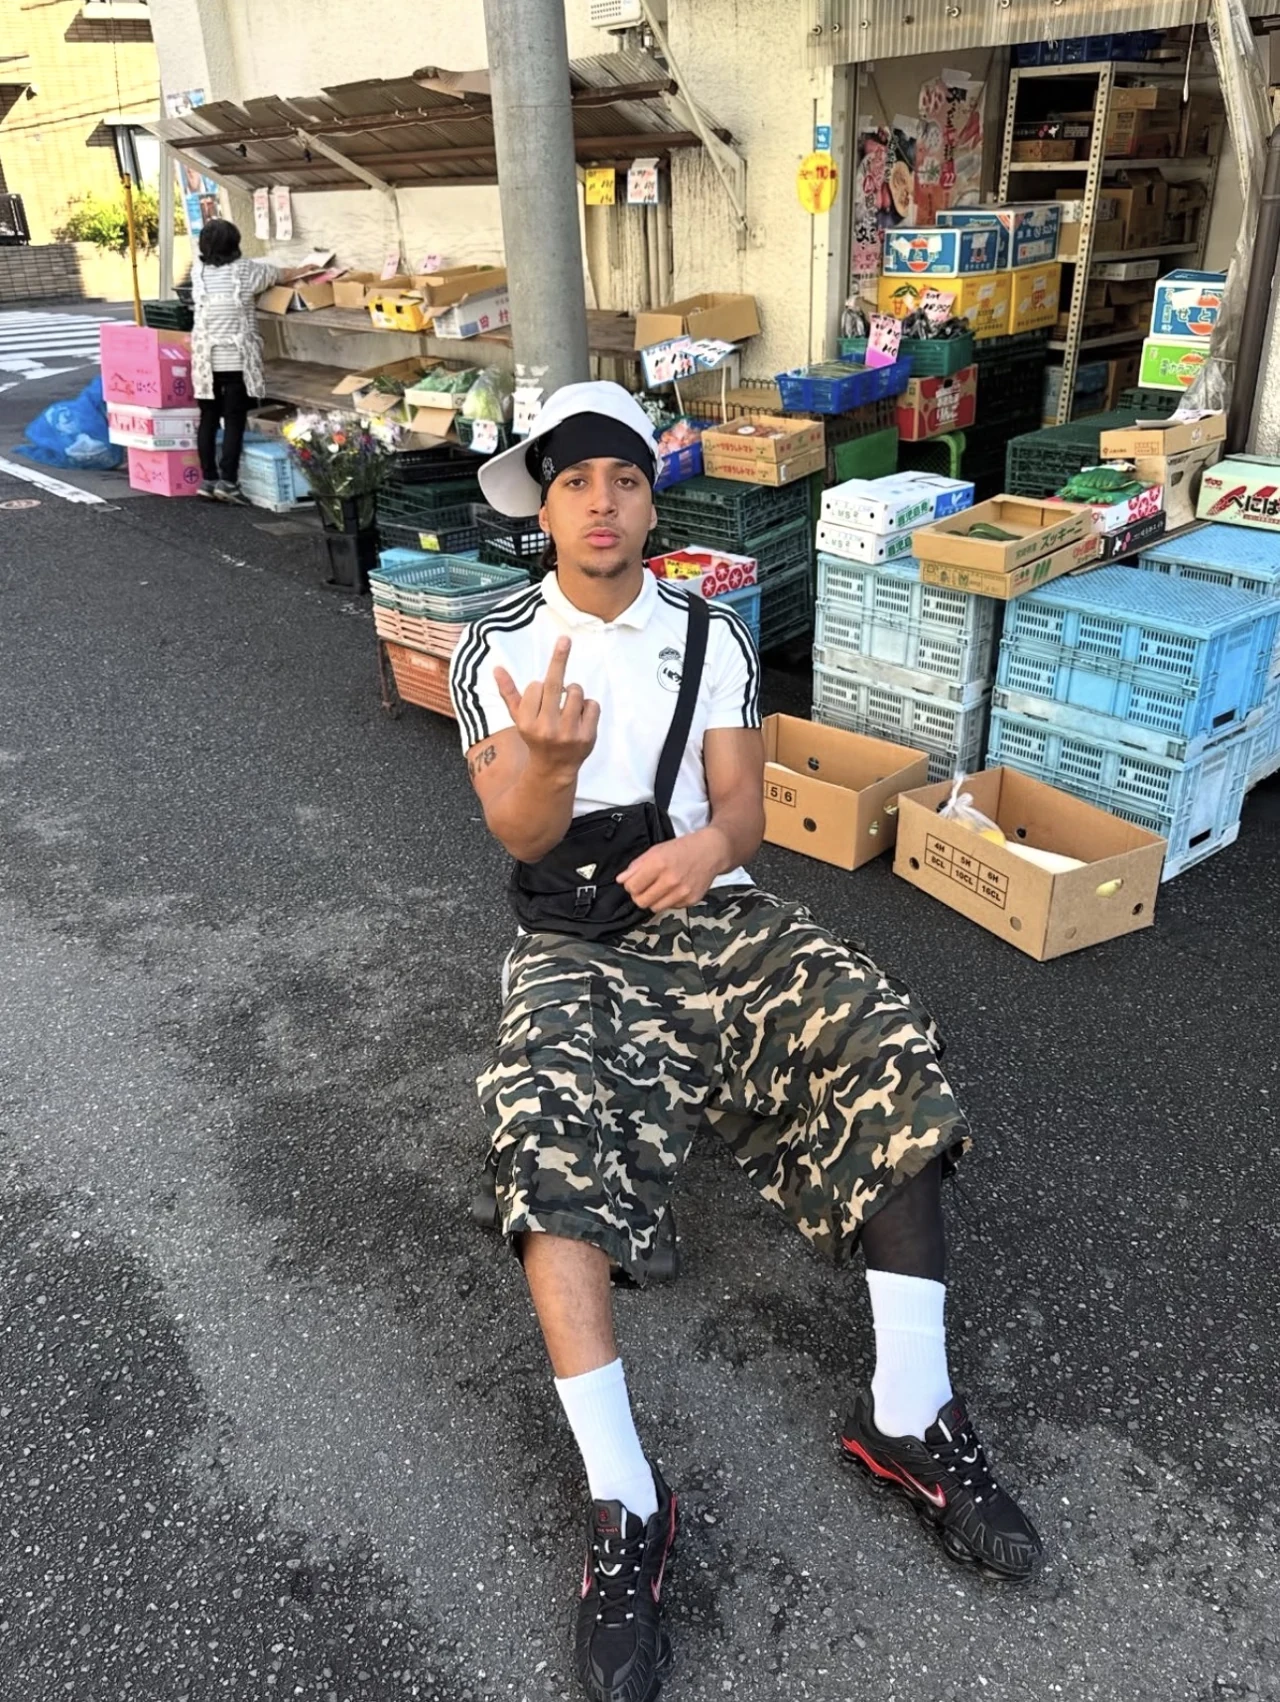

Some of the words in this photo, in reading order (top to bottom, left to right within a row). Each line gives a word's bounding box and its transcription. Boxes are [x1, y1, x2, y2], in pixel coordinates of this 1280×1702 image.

[1041, 520, 1083, 550] ズッキーニ
[769, 786, 778, 798] 5
[784, 791, 793, 803] 6
[931, 855, 946, 869] 8CL
[955, 870, 974, 886] 10CL
[934, 842, 945, 853] 4H
[960, 856, 972, 867] 5H
[987, 871, 999, 883] 6H
